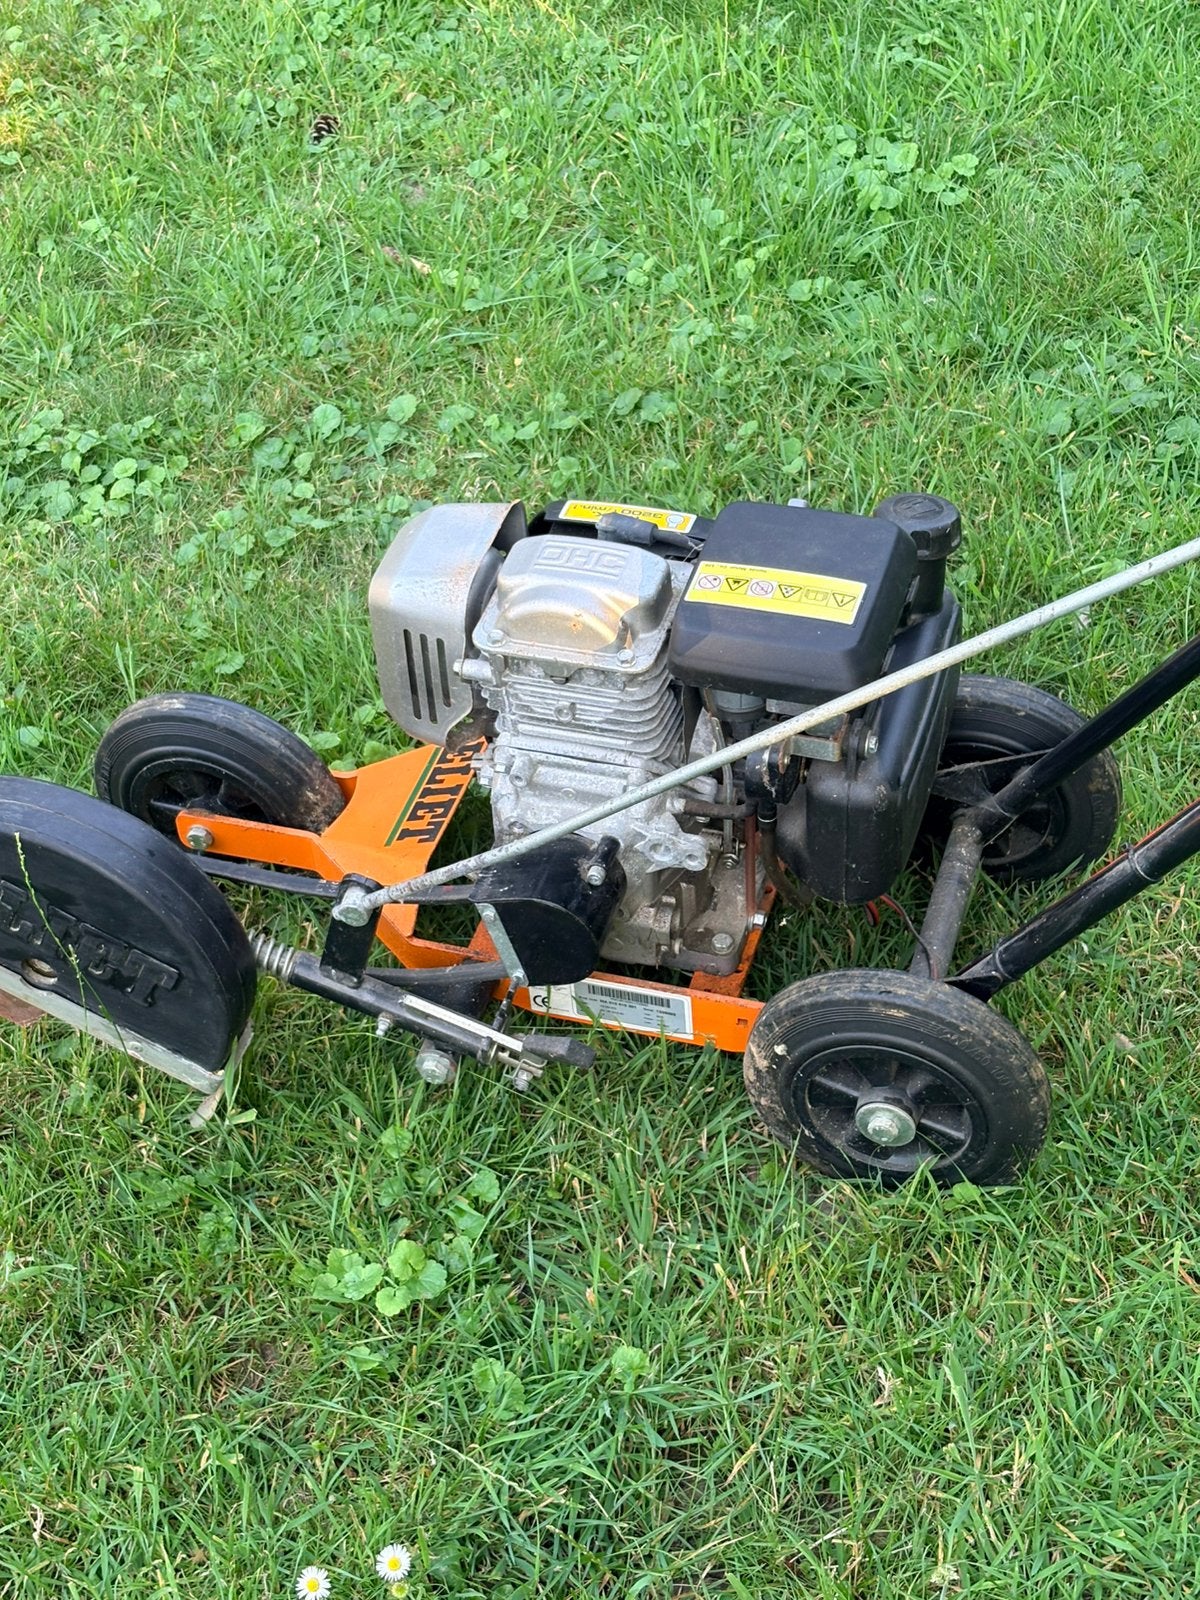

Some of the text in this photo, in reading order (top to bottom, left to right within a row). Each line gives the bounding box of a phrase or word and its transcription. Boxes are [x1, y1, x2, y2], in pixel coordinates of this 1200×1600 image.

[620, 507, 663, 519] 3200
[536, 545, 627, 570] OHC
[396, 742, 483, 843] ELIET
